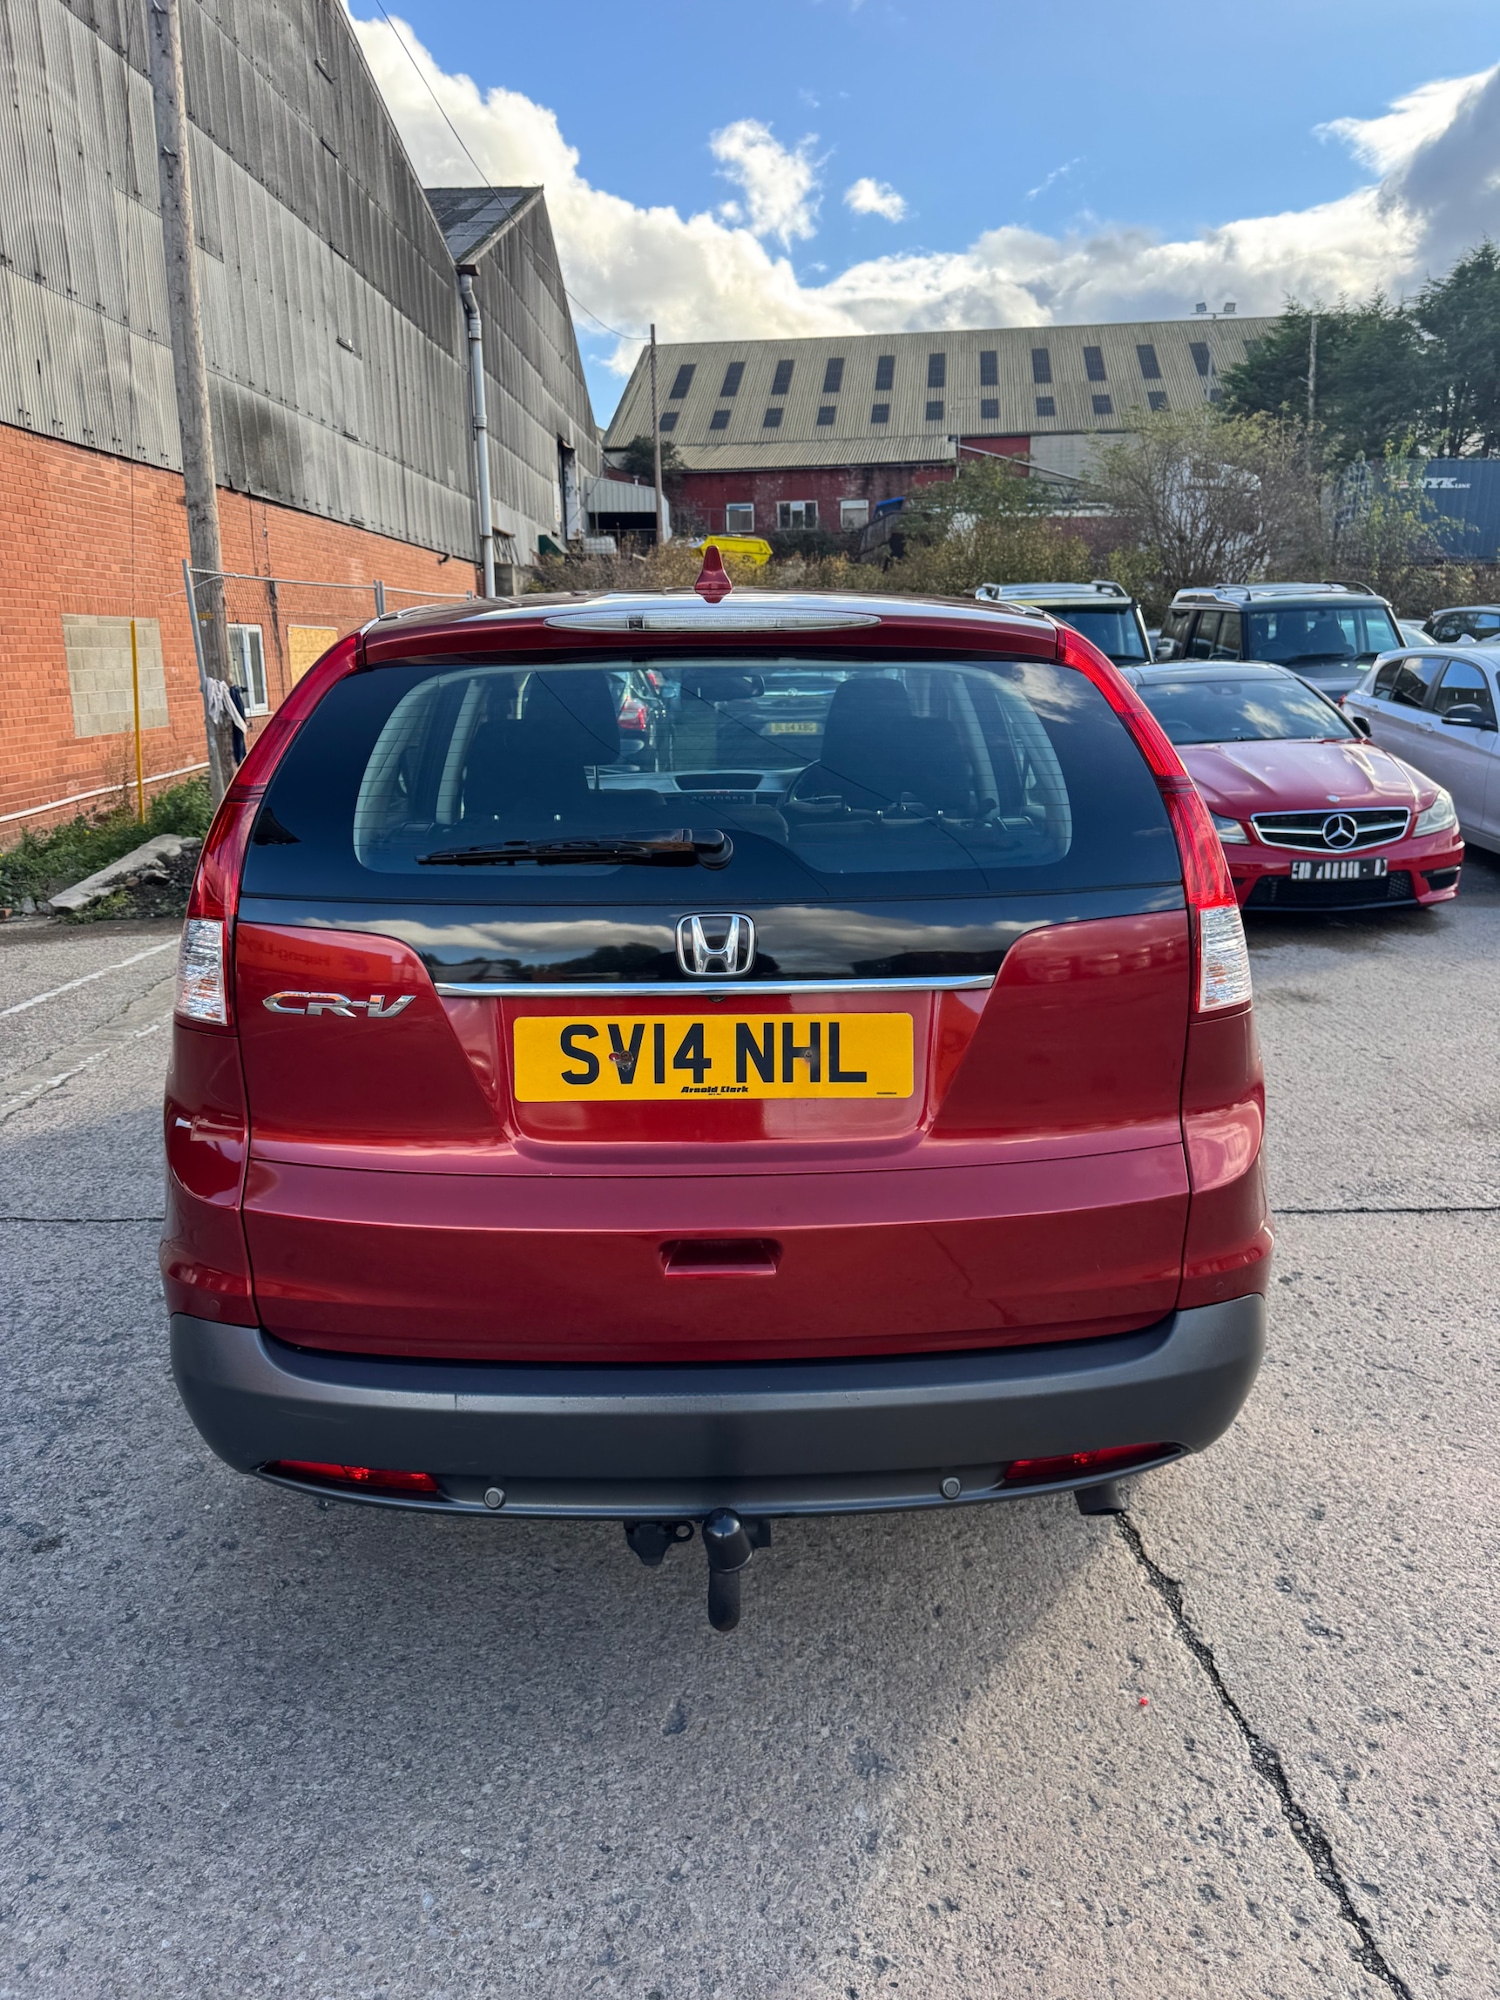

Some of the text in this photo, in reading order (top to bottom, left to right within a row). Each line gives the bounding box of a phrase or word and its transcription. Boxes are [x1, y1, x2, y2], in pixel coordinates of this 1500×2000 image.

[1417, 477, 1457, 488] NYK
[262, 990, 417, 1018] CR-V
[560, 1022, 867, 1084] SV14 NHL
[681, 1085, 749, 1093] Arnold Clark
